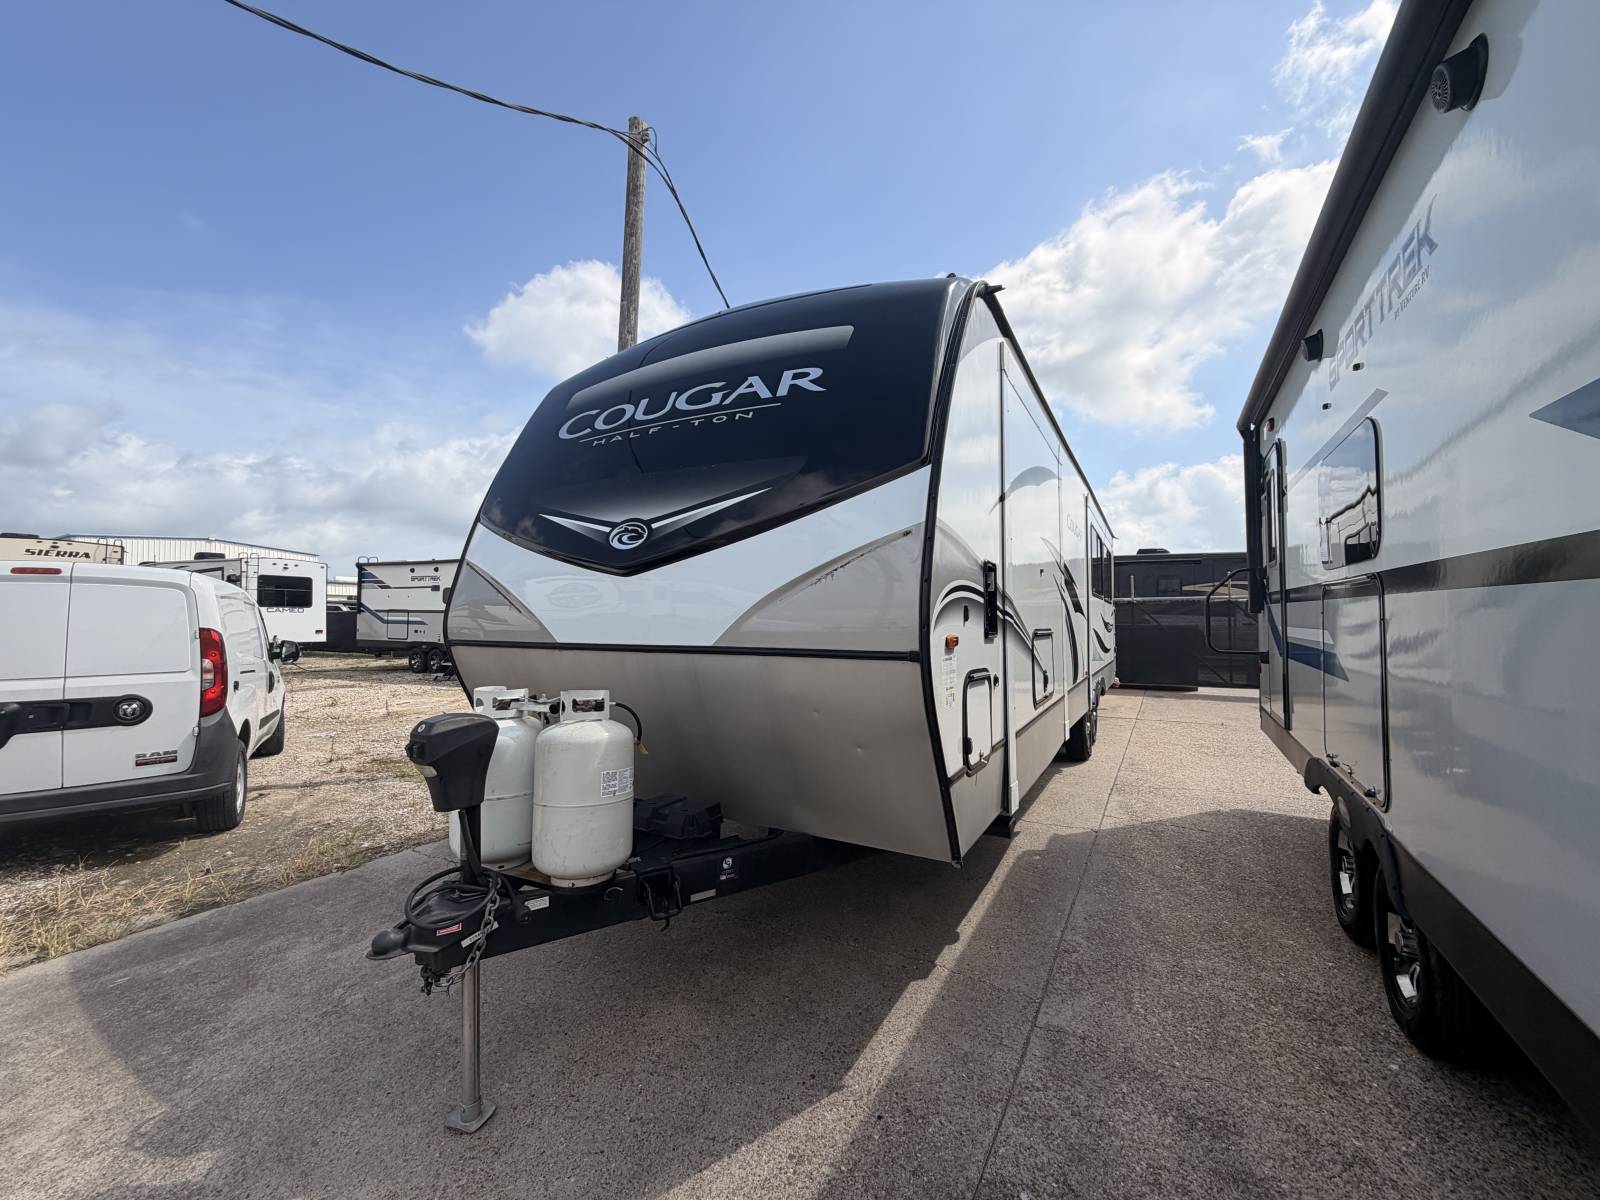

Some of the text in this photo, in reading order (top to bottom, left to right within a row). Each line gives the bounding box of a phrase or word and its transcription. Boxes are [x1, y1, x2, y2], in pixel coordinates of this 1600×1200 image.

[558, 367, 827, 440] COUGAR
[592, 411, 754, 447] HALF-TON
[23, 548, 92, 559] SIERRA
[135, 750, 178, 759] RAM
